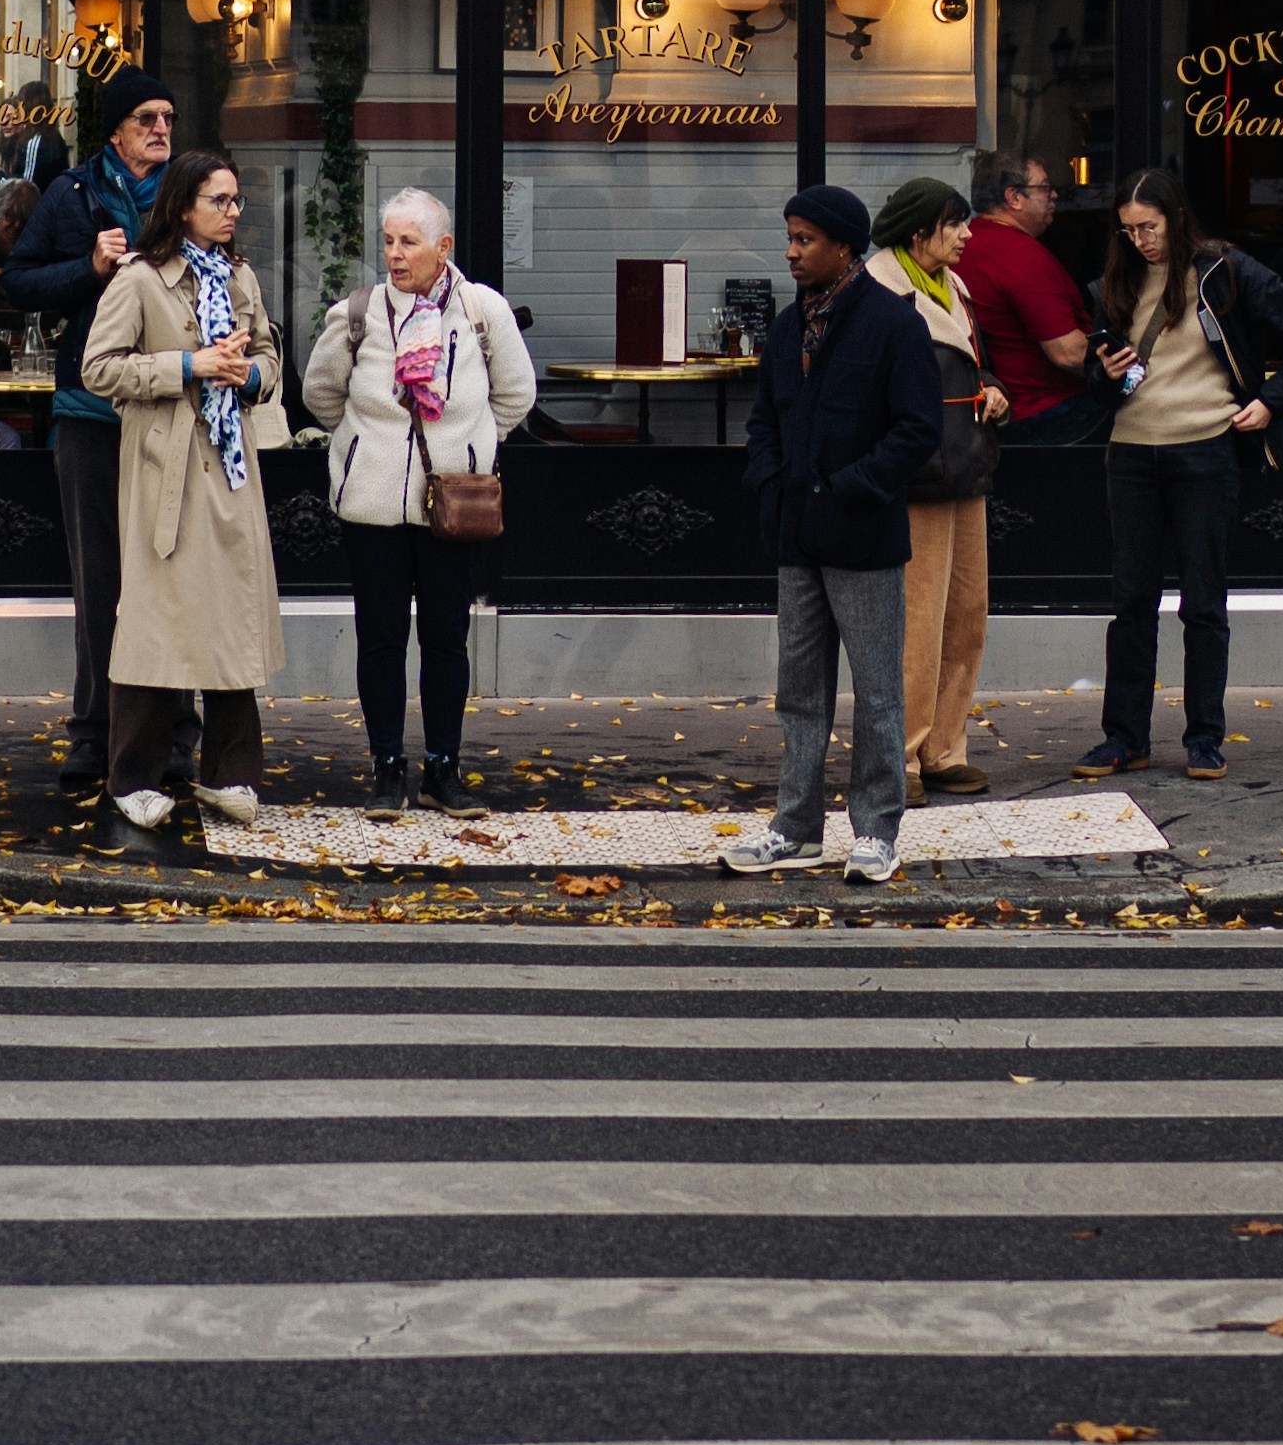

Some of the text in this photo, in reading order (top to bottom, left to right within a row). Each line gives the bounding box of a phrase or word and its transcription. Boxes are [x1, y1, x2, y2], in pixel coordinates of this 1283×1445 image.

[2, 21, 42, 59] du
[538, 21, 754, 77] TARTARE
[528, 82, 783, 145] Aveyronnais
